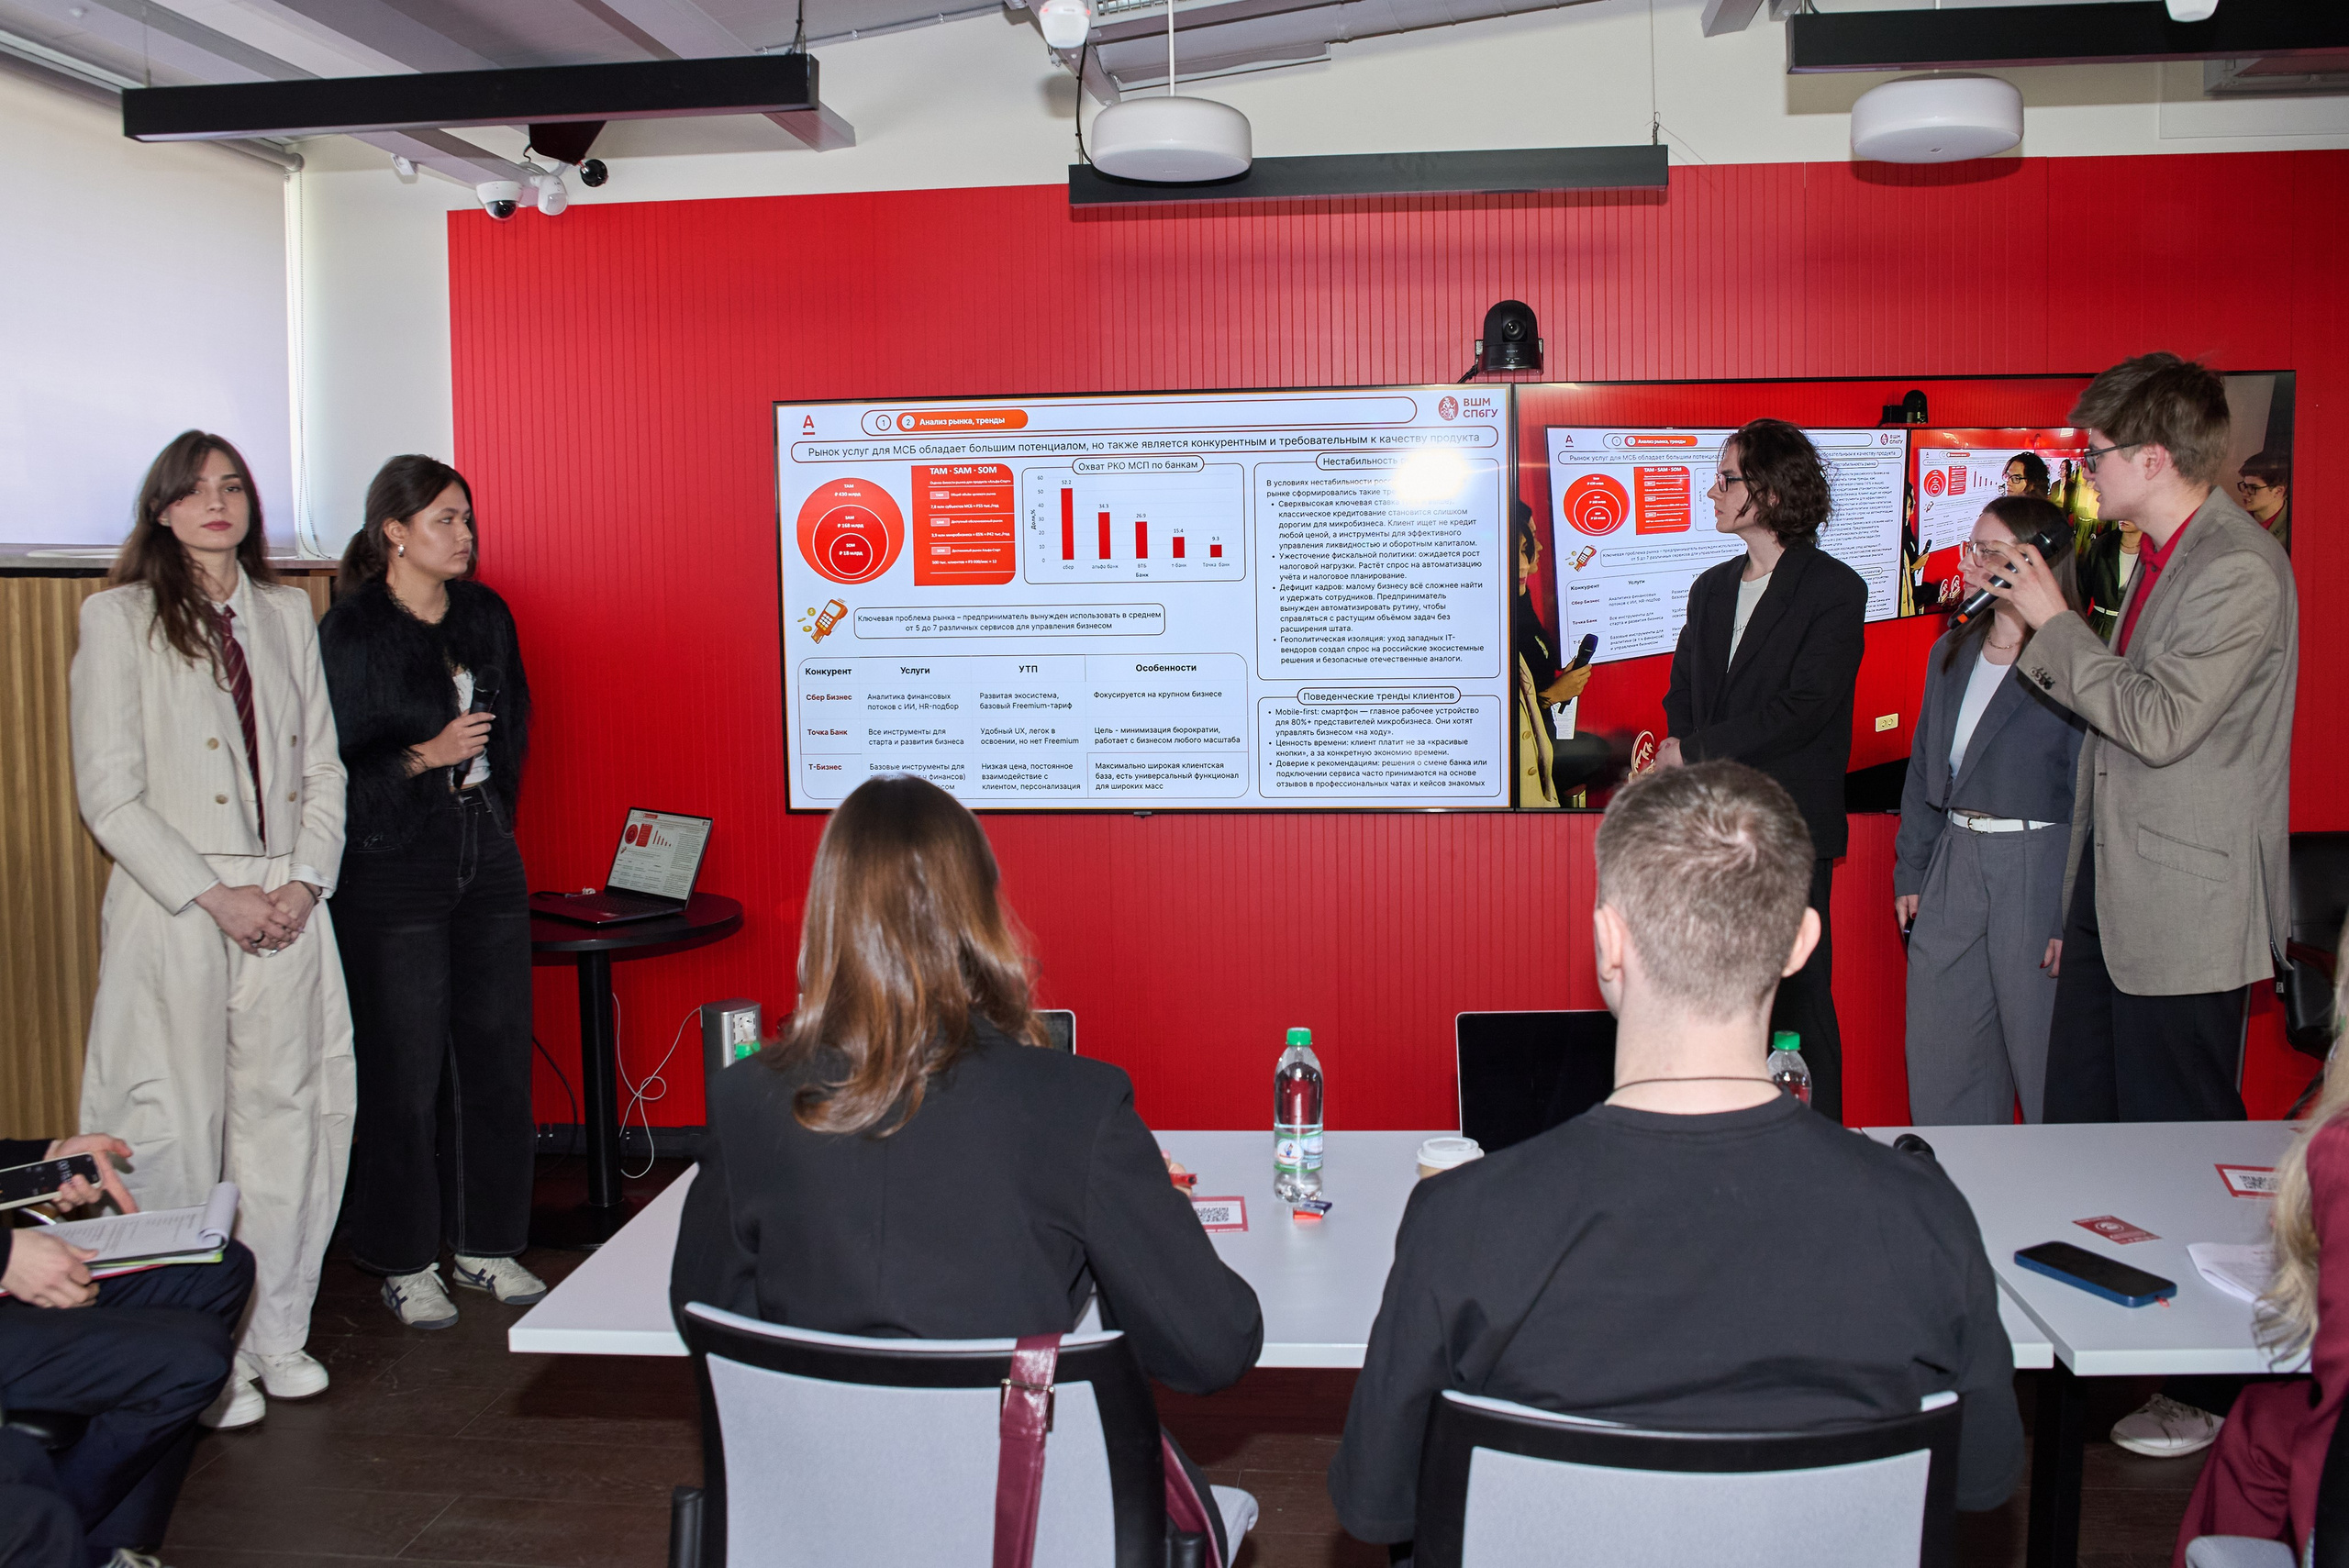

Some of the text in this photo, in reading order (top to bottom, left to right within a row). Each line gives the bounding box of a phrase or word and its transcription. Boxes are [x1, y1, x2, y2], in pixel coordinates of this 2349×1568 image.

[1463, 397, 1490, 406] ВШМ
[1463, 408, 1498, 417] СПбГУ
[807, 447, 840, 456] Рынок
[841, 448, 869, 458] услуг
[872, 447, 890, 456] для
[893, 445, 916, 454] МСБ
[918, 443, 966, 454] обладает
[968, 442, 1015, 452] большим
[1018, 442, 1088, 452] потенциалом,
[1191, 439, 1266, 449] конкурентным
[1278, 434, 1367, 447] требовательным
[1379, 435, 1427, 443] качеству
[1322, 456, 1397, 465] Нестабильность
[1078, 462, 1105, 471] Охват
[1107, 462, 1125, 470] РКО
[1128, 461, 1149, 469] МСП
[1164, 460, 1197, 468] банкам
[1279, 584, 1312, 592] Дефицит
[1376, 582, 1408, 591] бизнесу
[895, 614, 930, 622] проблема
[805, 667, 852, 676] Конкурент
[899, 666, 930, 675] Услуги
[1135, 663, 1197, 672] Особенности
[1093, 691, 1145, 699] Фокусируется
[1303, 692, 1374, 701] Поведенческие
[1375, 693, 1410, 701] тренды
[918, 702, 959, 710] HR-подбор
[1401, 706, 1433, 715] рабочее
[1434, 706, 1479, 715] устройство
[1313, 717, 1375, 726] представителей
[1376, 717, 1433, 726] микробизнеса.
